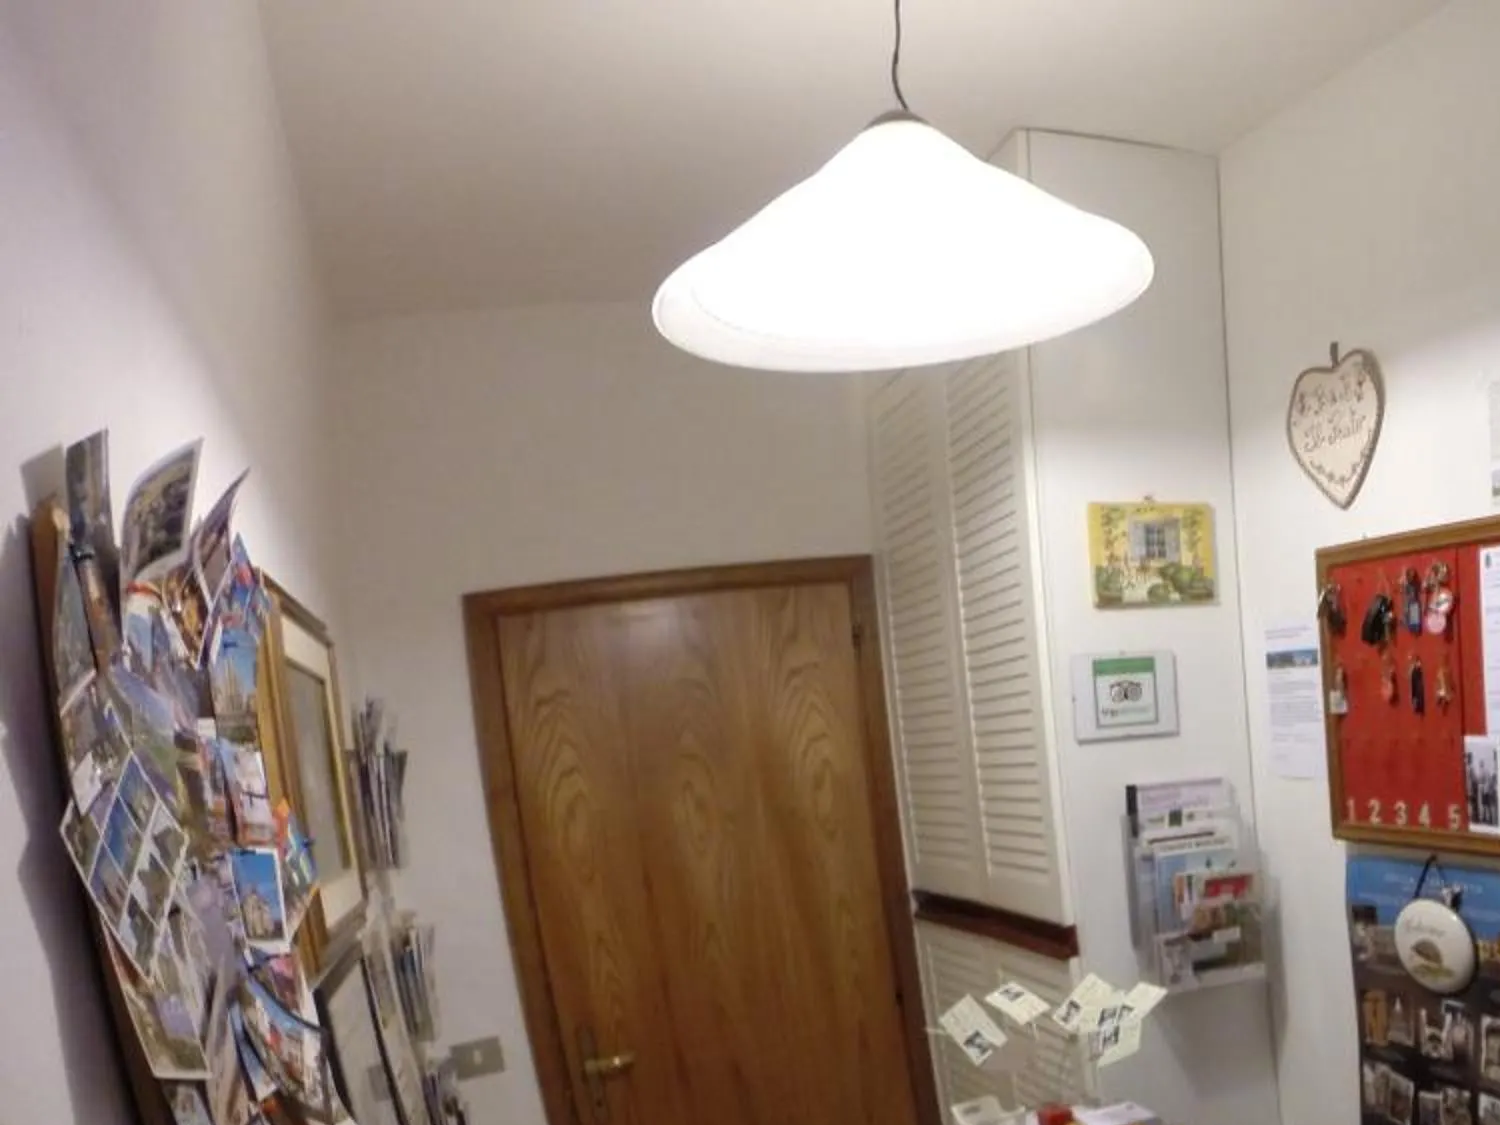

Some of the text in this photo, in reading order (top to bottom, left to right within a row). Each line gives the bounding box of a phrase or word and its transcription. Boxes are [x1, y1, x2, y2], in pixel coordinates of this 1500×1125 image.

[1345, 797, 1461, 832] 1 2 3 4 5
